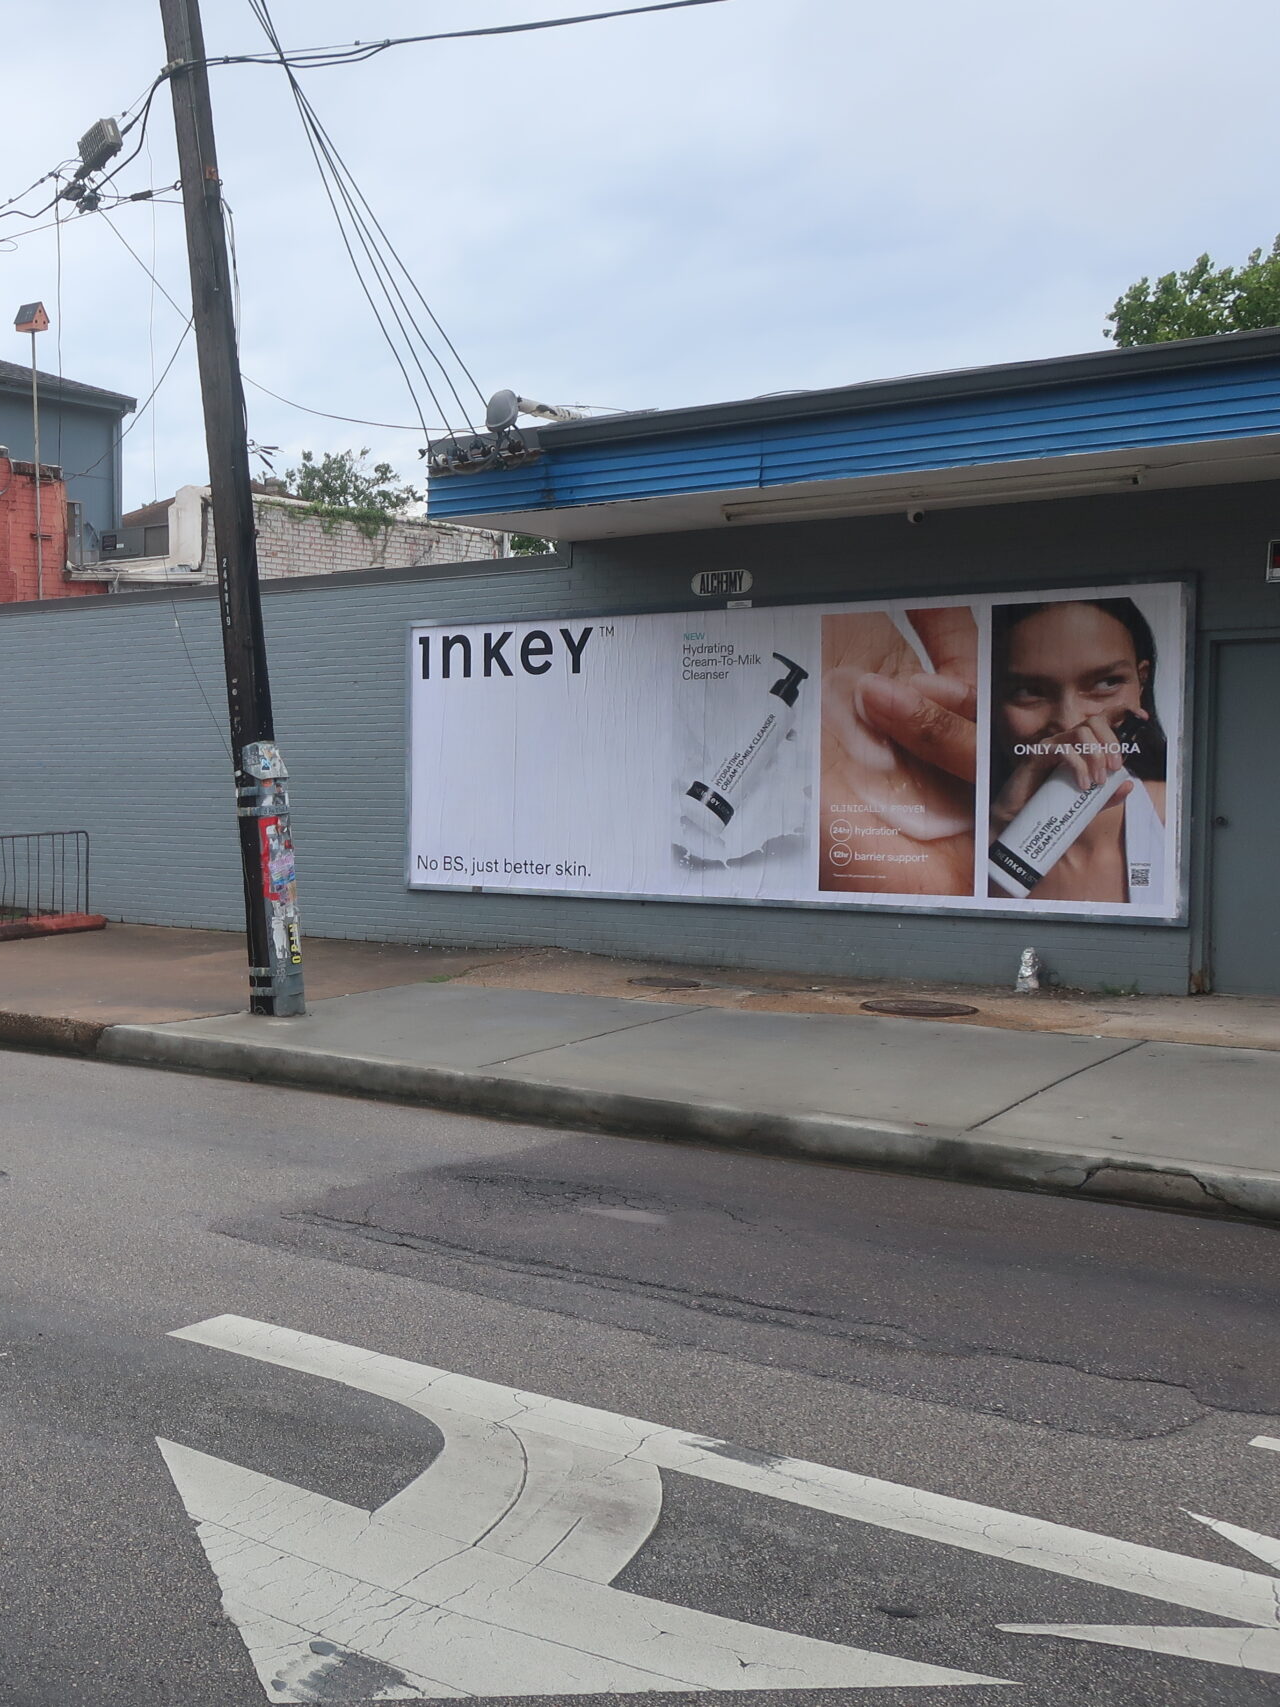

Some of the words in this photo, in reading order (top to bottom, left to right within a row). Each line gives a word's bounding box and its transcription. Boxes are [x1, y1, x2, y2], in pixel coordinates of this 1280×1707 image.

[683, 632, 705, 640] NEW
[683, 643, 734, 657] Hydrating
[682, 654, 761, 667] Cream-To-Milk
[682, 669, 729, 680] Cleanser
[752, 713, 776, 745] CLEANSER
[1014, 743, 1051, 755] ONLY
[1054, 743, 1070, 755] AT
[1073, 743, 1141, 755] SEPHORA
[715, 752, 741, 787] HYDRATING
[1024, 816, 1058, 855] HYDRATING
[1030, 807, 1077, 860] CREAM-TO-MILK
[854, 851, 886, 860] barrier
[417, 855, 438, 870] No
[443, 856, 468, 874] BS,
[471, 857, 499, 876] just
[504, 858, 551, 876] better
[555, 860, 592, 877] skin.
